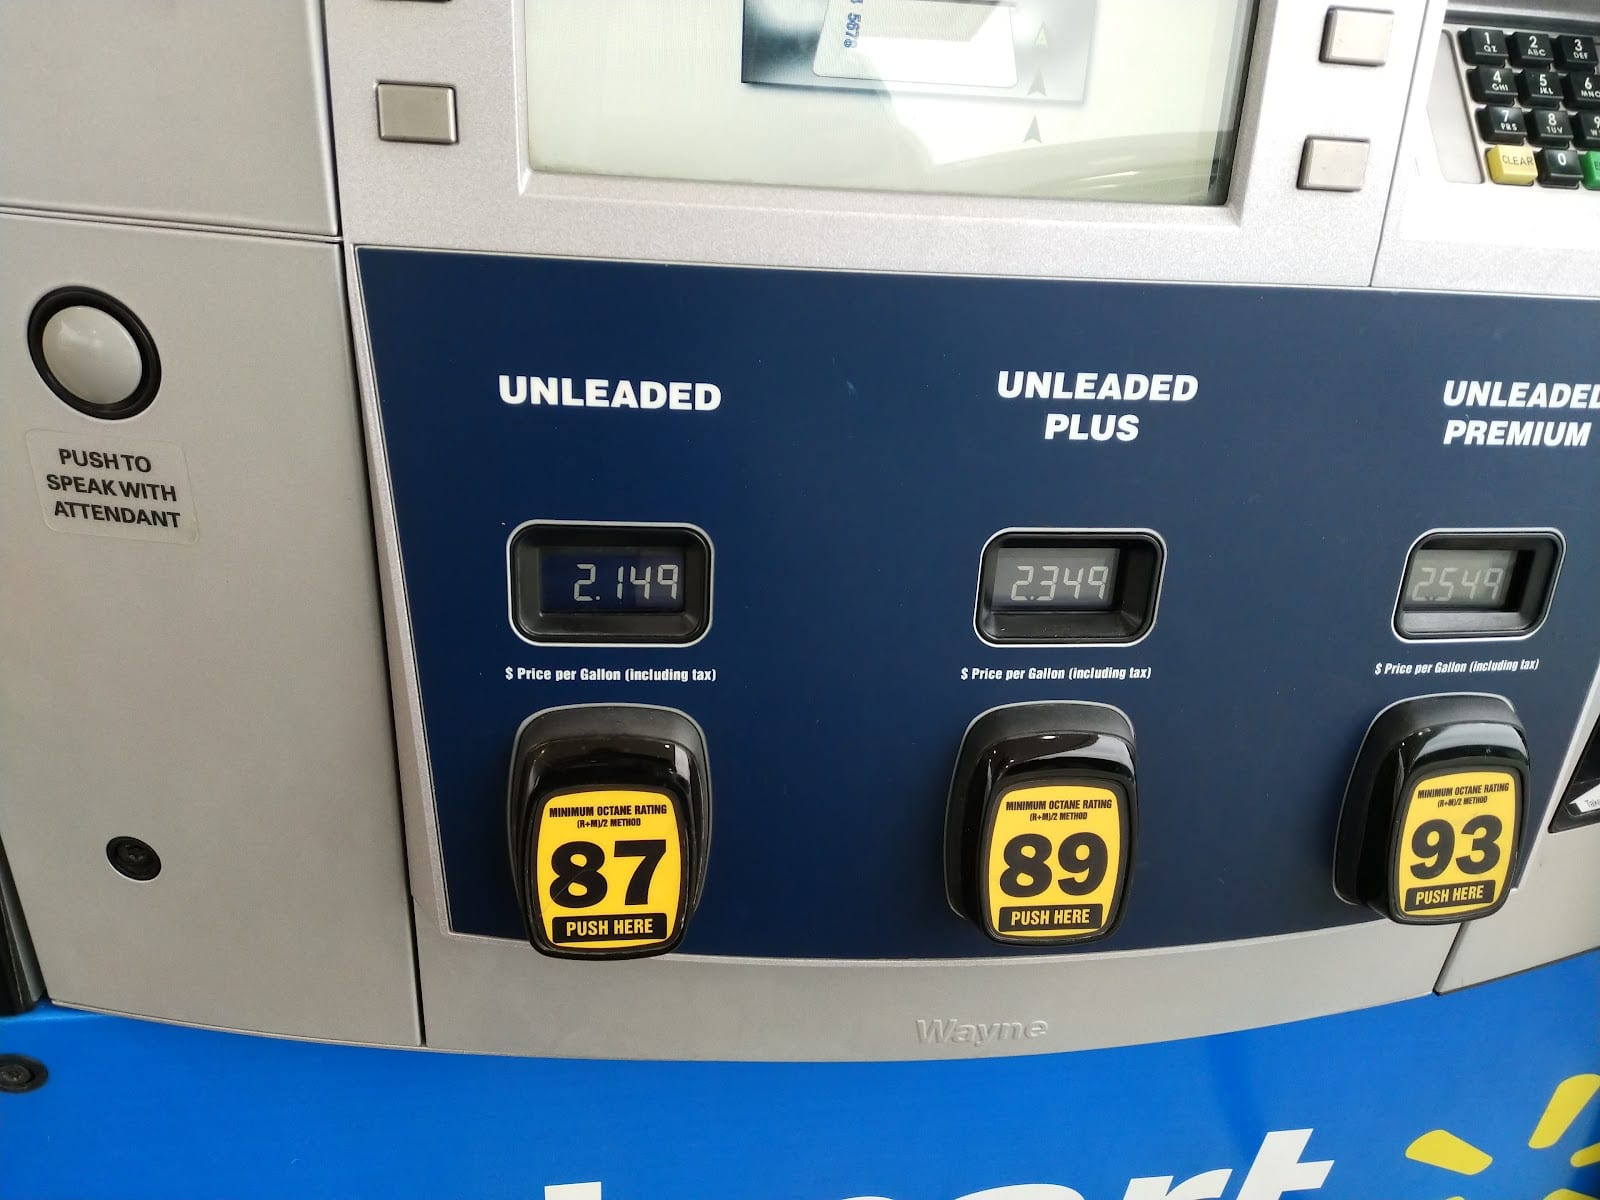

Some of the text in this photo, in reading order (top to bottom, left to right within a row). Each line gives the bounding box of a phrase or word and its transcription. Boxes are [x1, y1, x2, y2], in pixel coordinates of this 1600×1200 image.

[1483, 32, 1491, 44] 1
[1528, 36, 1538, 48] 2
[1483, 45, 1498, 53] QZ
[1574, 39, 1583, 52] 3
[1528, 49, 1546, 57] ABC
[1573, 52, 1589, 60] DEF
[1493, 71, 1502, 83] 4
[1539, 74, 1548, 87] 5
[1584, 77, 1593, 90] 6
[1492, 83, 1508, 91] GHI
[1539, 87, 1554, 95] JKL
[1501, 110, 1509, 122] 7
[1547, 113, 1557, 126] 8
[1593, 116, 1600, 128] 9
[1501, 123, 1517, 131] PRS
[1546, 126, 1563, 134] TUV
[1502, 154, 1533, 166] CLEAR
[1557, 152, 1567, 165] 0
[998, 370, 1199, 401] UNLEADED
[499, 375, 722, 411] UNLEADED
[1044, 413, 1140, 442] PLUS
[1443, 419, 1592, 446] PREMIUM
[58, 448, 151, 473] PUSH TO
[46, 474, 177, 502] SPEAK WITH
[54, 500, 181, 528] ATTENDANT
[573, 563, 679, 602] 2.149
[1010, 565, 1109, 602] 2.349
[1411, 567, 1504, 602] 2.549
[960, 666, 1152, 681] $ Price per Gallon (including tax)
[1375, 659, 1540, 675] $ Price per Gallon (including tax)
[505, 666, 717, 682] $ Price per Gallon (including tax)
[1417, 783, 1510, 799] MINIMUM OCTANE RATING
[1006, 799, 1112, 811] MINIMUM OCTANE RATING
[1463, 796, 1488, 805] METHOD
[549, 804, 667, 818] MINIMUM OCTANE RATING
[1029, 812, 1088, 822] (R+M)/2 METHOD
[577, 818, 641, 829] (R+M)/2 METHOD
[1410, 814, 1503, 880] 93
[1000, 832, 1108, 898] 89
[549, 839, 667, 909] 87
[1415, 885, 1484, 905] PUSH HERE
[1010, 908, 1091, 926] PUSH HERE
[566, 918, 653, 937] PUSH HERE
[915, 1018, 1049, 1047] Wayne
